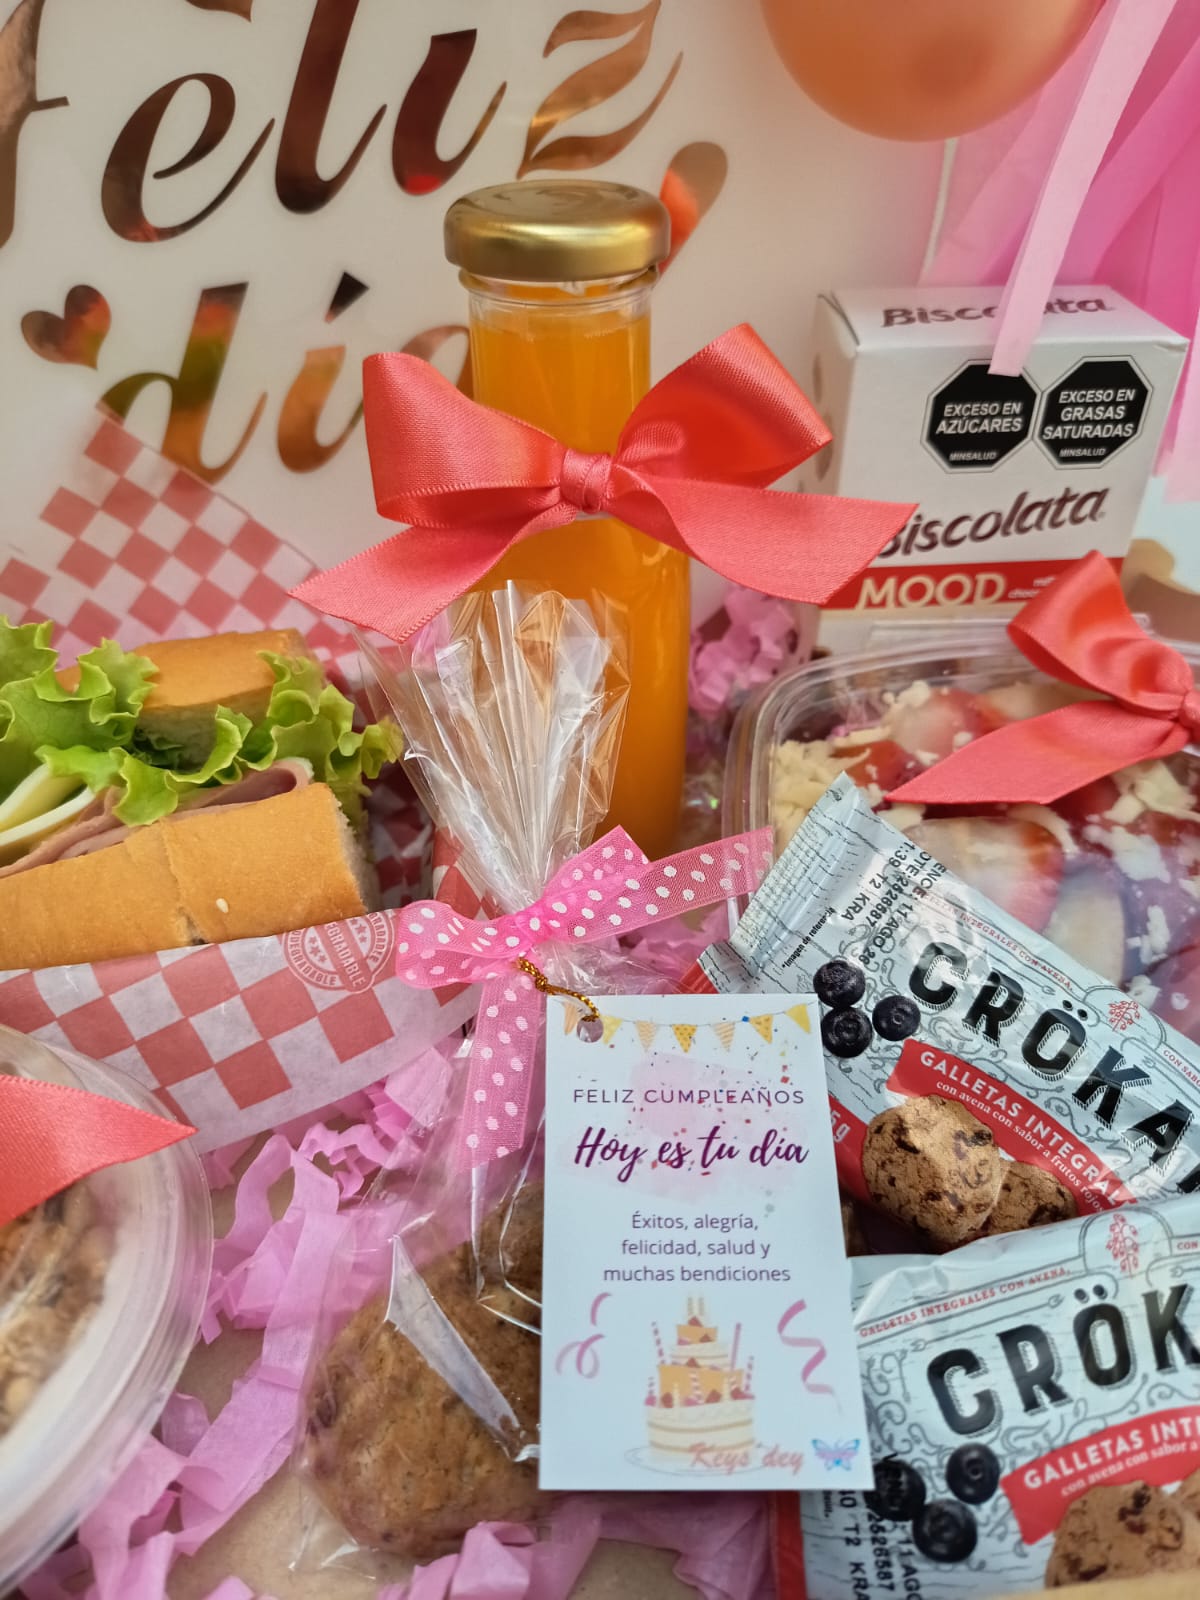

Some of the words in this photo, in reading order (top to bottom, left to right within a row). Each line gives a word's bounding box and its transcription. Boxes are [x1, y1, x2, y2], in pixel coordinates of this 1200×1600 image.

[881, 298, 1113, 327] Biscta
[1059, 389, 1114, 403] EXCESO
[1115, 389, 1135, 402] EN
[943, 403, 1000, 417] EXCESO
[1002, 402, 1022, 415] EN
[1060, 406, 1125, 421] GRASAS
[935, 416, 1023, 434] AZÚCARES
[1042, 423, 1134, 440] SATURADAS
[949, 451, 997, 461] MINSALUD
[1059, 448, 1105, 458] MINSALUD
[854, 572, 1006, 610] MOOD
[869, 872, 889, 889] T2
[840, 892, 871, 921] KRA
[872, 916, 900, 949] AGO
[959, 912, 1018, 951] INTEGRALES
[1019, 949, 1040, 967] CON
[910, 942, 1200, 1193] CRÖKA
[1163, 1049, 1182, 1067] CON
[573, 1089, 634, 1104] FELIZ
[644, 1086, 805, 1104] CUMPLEAÑOS
[920, 1051, 1023, 1118] GALLETAS
[1025, 1114, 1121, 1206] INTEGRAL
[936, 1081, 958, 1096] con
[959, 1092, 991, 1114] avena
[992, 1110, 1013, 1129] con
[1013, 1125, 1044, 1152] sabor
[1042, 1149, 1051, 1158] a
[1050, 1154, 1082, 1187] frutos
[573, 1126, 648, 1182] Hoy
[658, 1141, 692, 1169] es
[697, 1125, 740, 1169] tu
[749, 1128, 810, 1167] día
[631, 1211, 689, 1230] Éxitos,
[694, 1214, 759, 1233] alegría,
[622, 1240, 702, 1257] felicidad,
[707, 1240, 756, 1255] salud
[760, 1243, 771, 1259] y
[1177, 1241, 1198, 1251] CON
[603, 1266, 675, 1281] muchas
[680, 1266, 791, 1281] bendiciones
[859, 1311, 918, 1338] GALLETAS
[921, 1289, 996, 1317] INTEGRALES
[999, 1280, 1026, 1294] CON
[1023, 1428, 1144, 1489] GALLETAS
[1061, 1480, 1086, 1497] con
[1088, 1463, 1124, 1486] avena
[1125, 1451, 1149, 1468] con
[1151, 1440, 1188, 1459] sabor
